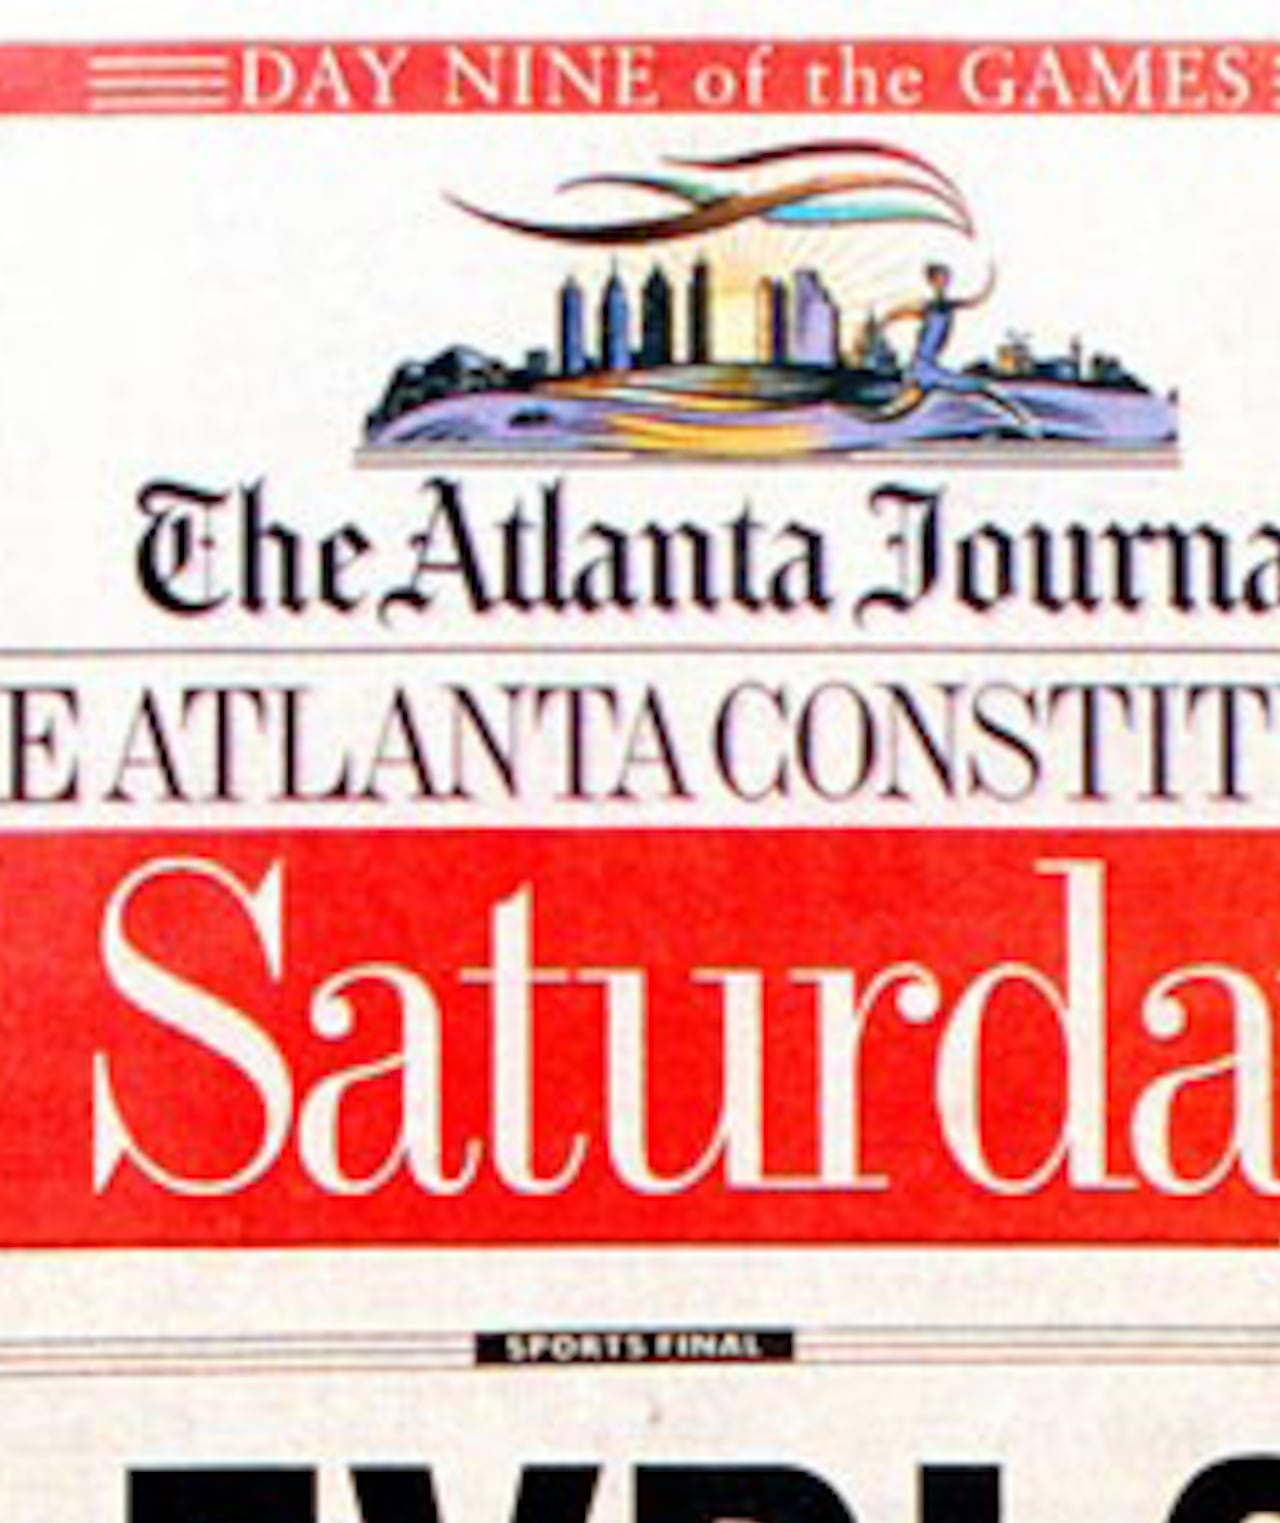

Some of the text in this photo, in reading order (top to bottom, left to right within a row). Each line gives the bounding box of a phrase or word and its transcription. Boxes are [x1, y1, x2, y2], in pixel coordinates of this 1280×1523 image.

[242, 44, 1250, 112] DAY NINE of the GAMES
[135, 481, 371, 617] The
[375, 477, 832, 626] Atlanta
[108, 685, 686, 804] ATLANTA
[507, 1334, 758, 1360] SPORTS FINAL
